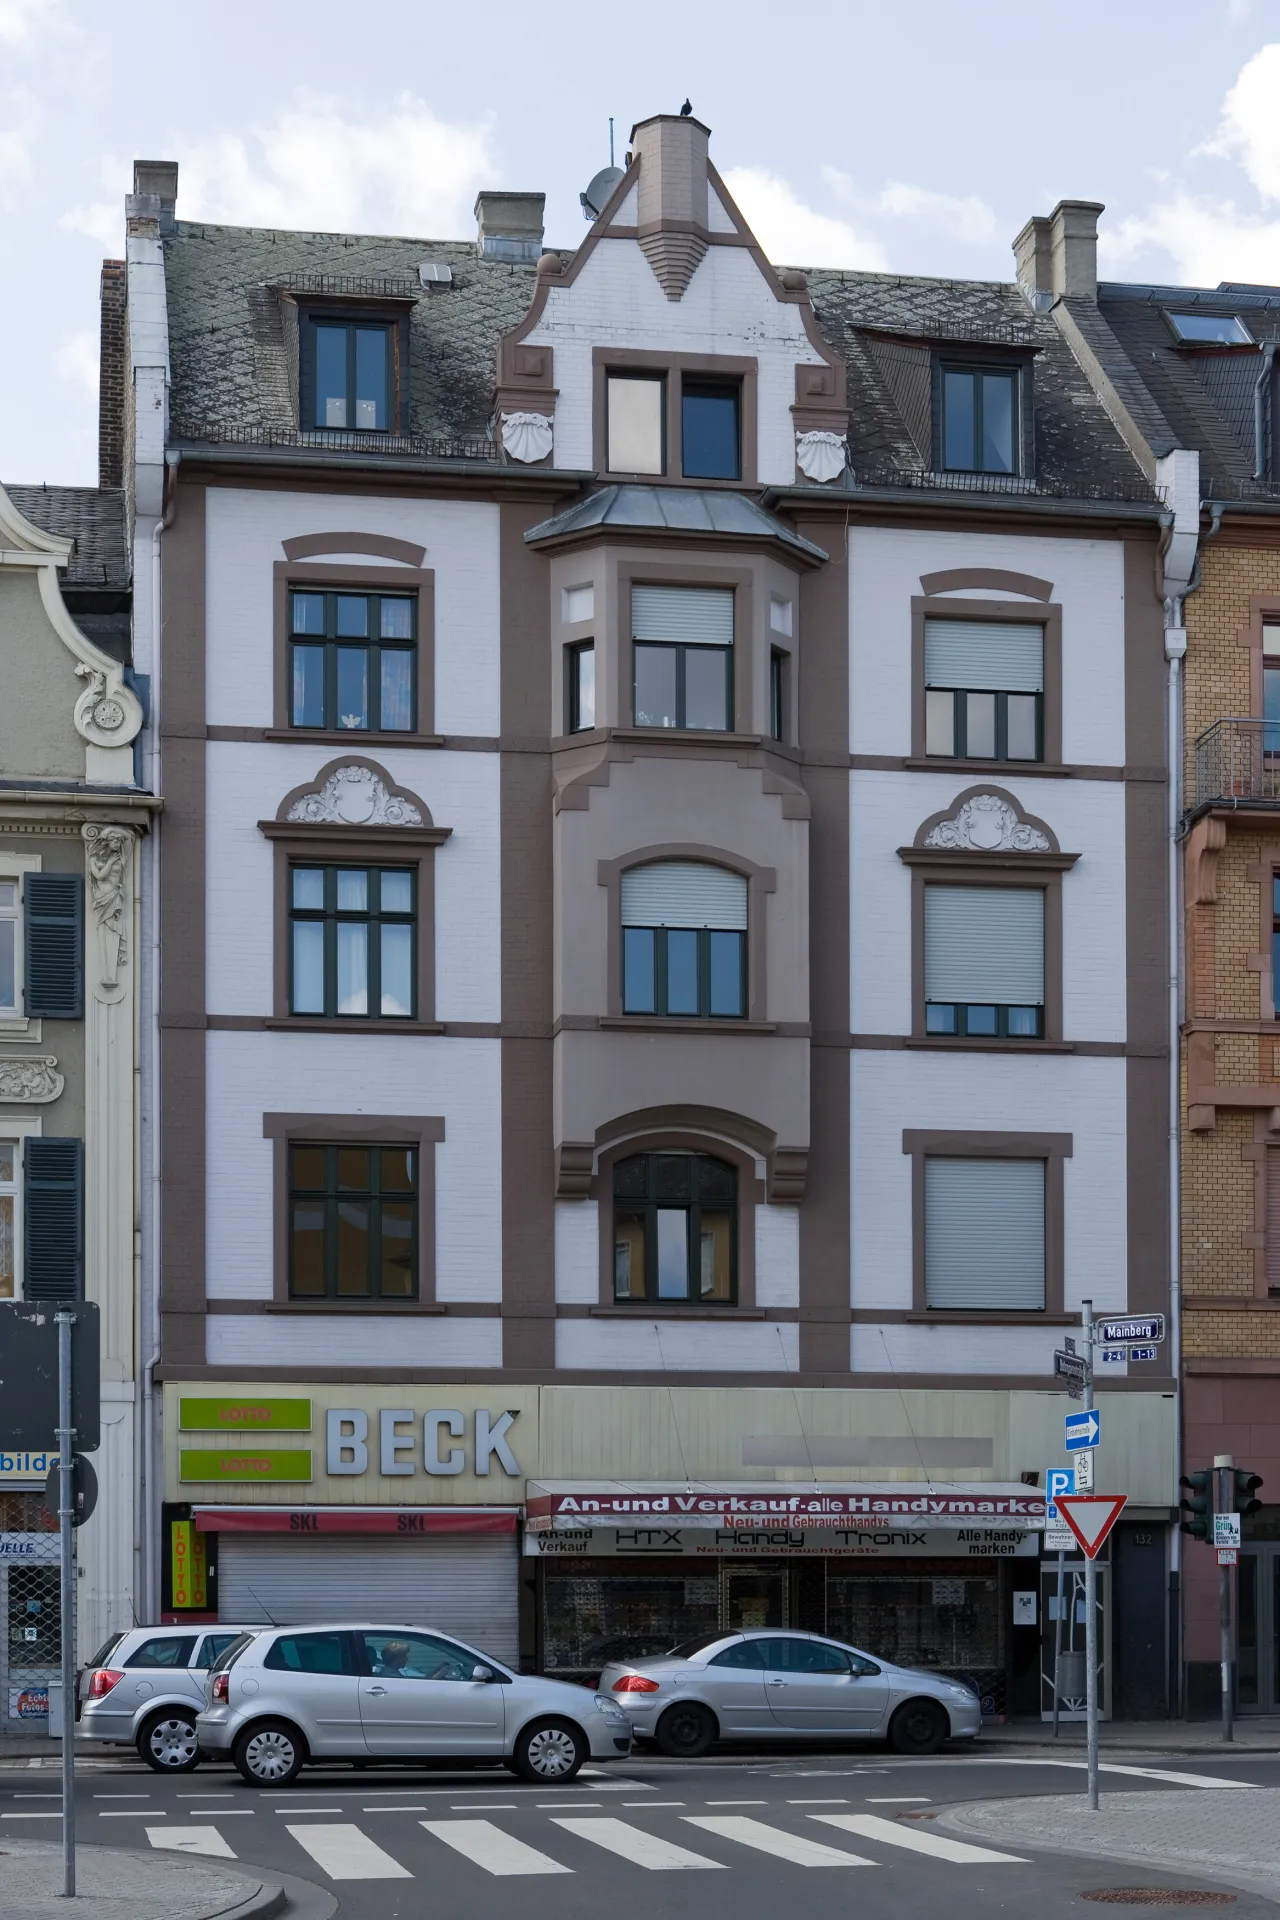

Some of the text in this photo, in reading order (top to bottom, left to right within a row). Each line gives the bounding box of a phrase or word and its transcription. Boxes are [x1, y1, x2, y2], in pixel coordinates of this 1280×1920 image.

[1107, 1325, 1151, 1339] Mainberg
[1108, 1352, 1121, 1361] 2-4
[1138, 1349, 1155, 1360] 1-13
[219, 1406, 272, 1422] LOTTO
[326, 1408, 522, 1476] BECK
[220, 1457, 272, 1473] LOTTO
[1052, 1473, 1069, 1498] P
[557, 1496, 670, 1512] An-und
[848, 1497, 1046, 1514] Handymarke
[289, 1513, 320, 1531] SKL
[397, 1513, 427, 1531] SKL
[723, 1514, 760, 1529] Neu-
[761, 1514, 790, 1529] und
[792, 1514, 890, 1529] Gebrauchthandys
[1216, 1521, 1232, 1530] Grün
[537, 1529, 593, 1540] An-und
[615, 1529, 927, 1548] HTX Handy Tronix
[957, 1529, 1027, 1545] Alle Handy-
[1135, 1533, 1152, 1545] 132
[537, 1541, 588, 1552] Verkauf
[760, 1546, 880, 1555] Gebrauchtgeräte
[968, 1541, 1016, 1555] marken
[175, 1524, 187, 1605] LOTTO
[28, 1693, 49, 1702] Echt
[21, 1702, 45, 1711] Fotos
